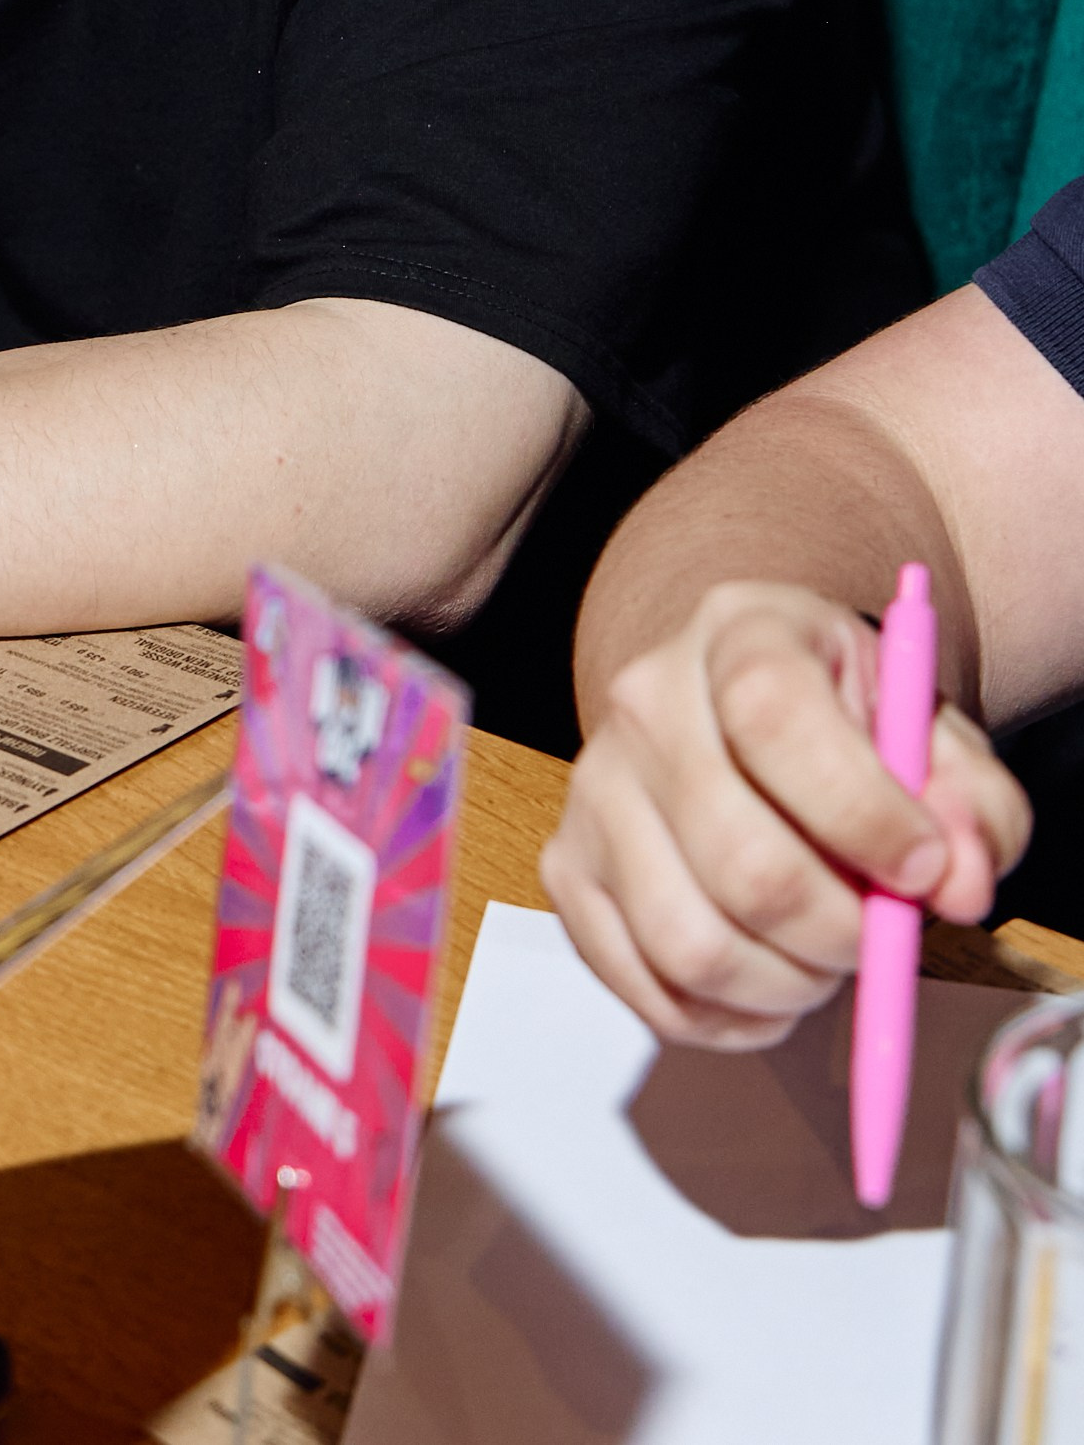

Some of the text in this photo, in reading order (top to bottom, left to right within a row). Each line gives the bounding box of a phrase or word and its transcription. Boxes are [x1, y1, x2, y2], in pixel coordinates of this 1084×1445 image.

[135, 638, 184, 658] ORIGINAL
[184, 657, 215, 667] MEIN
[182, 666, 243, 687] SCHNEIDER
[109, 696, 179, 720] HEFEWEIZEN
